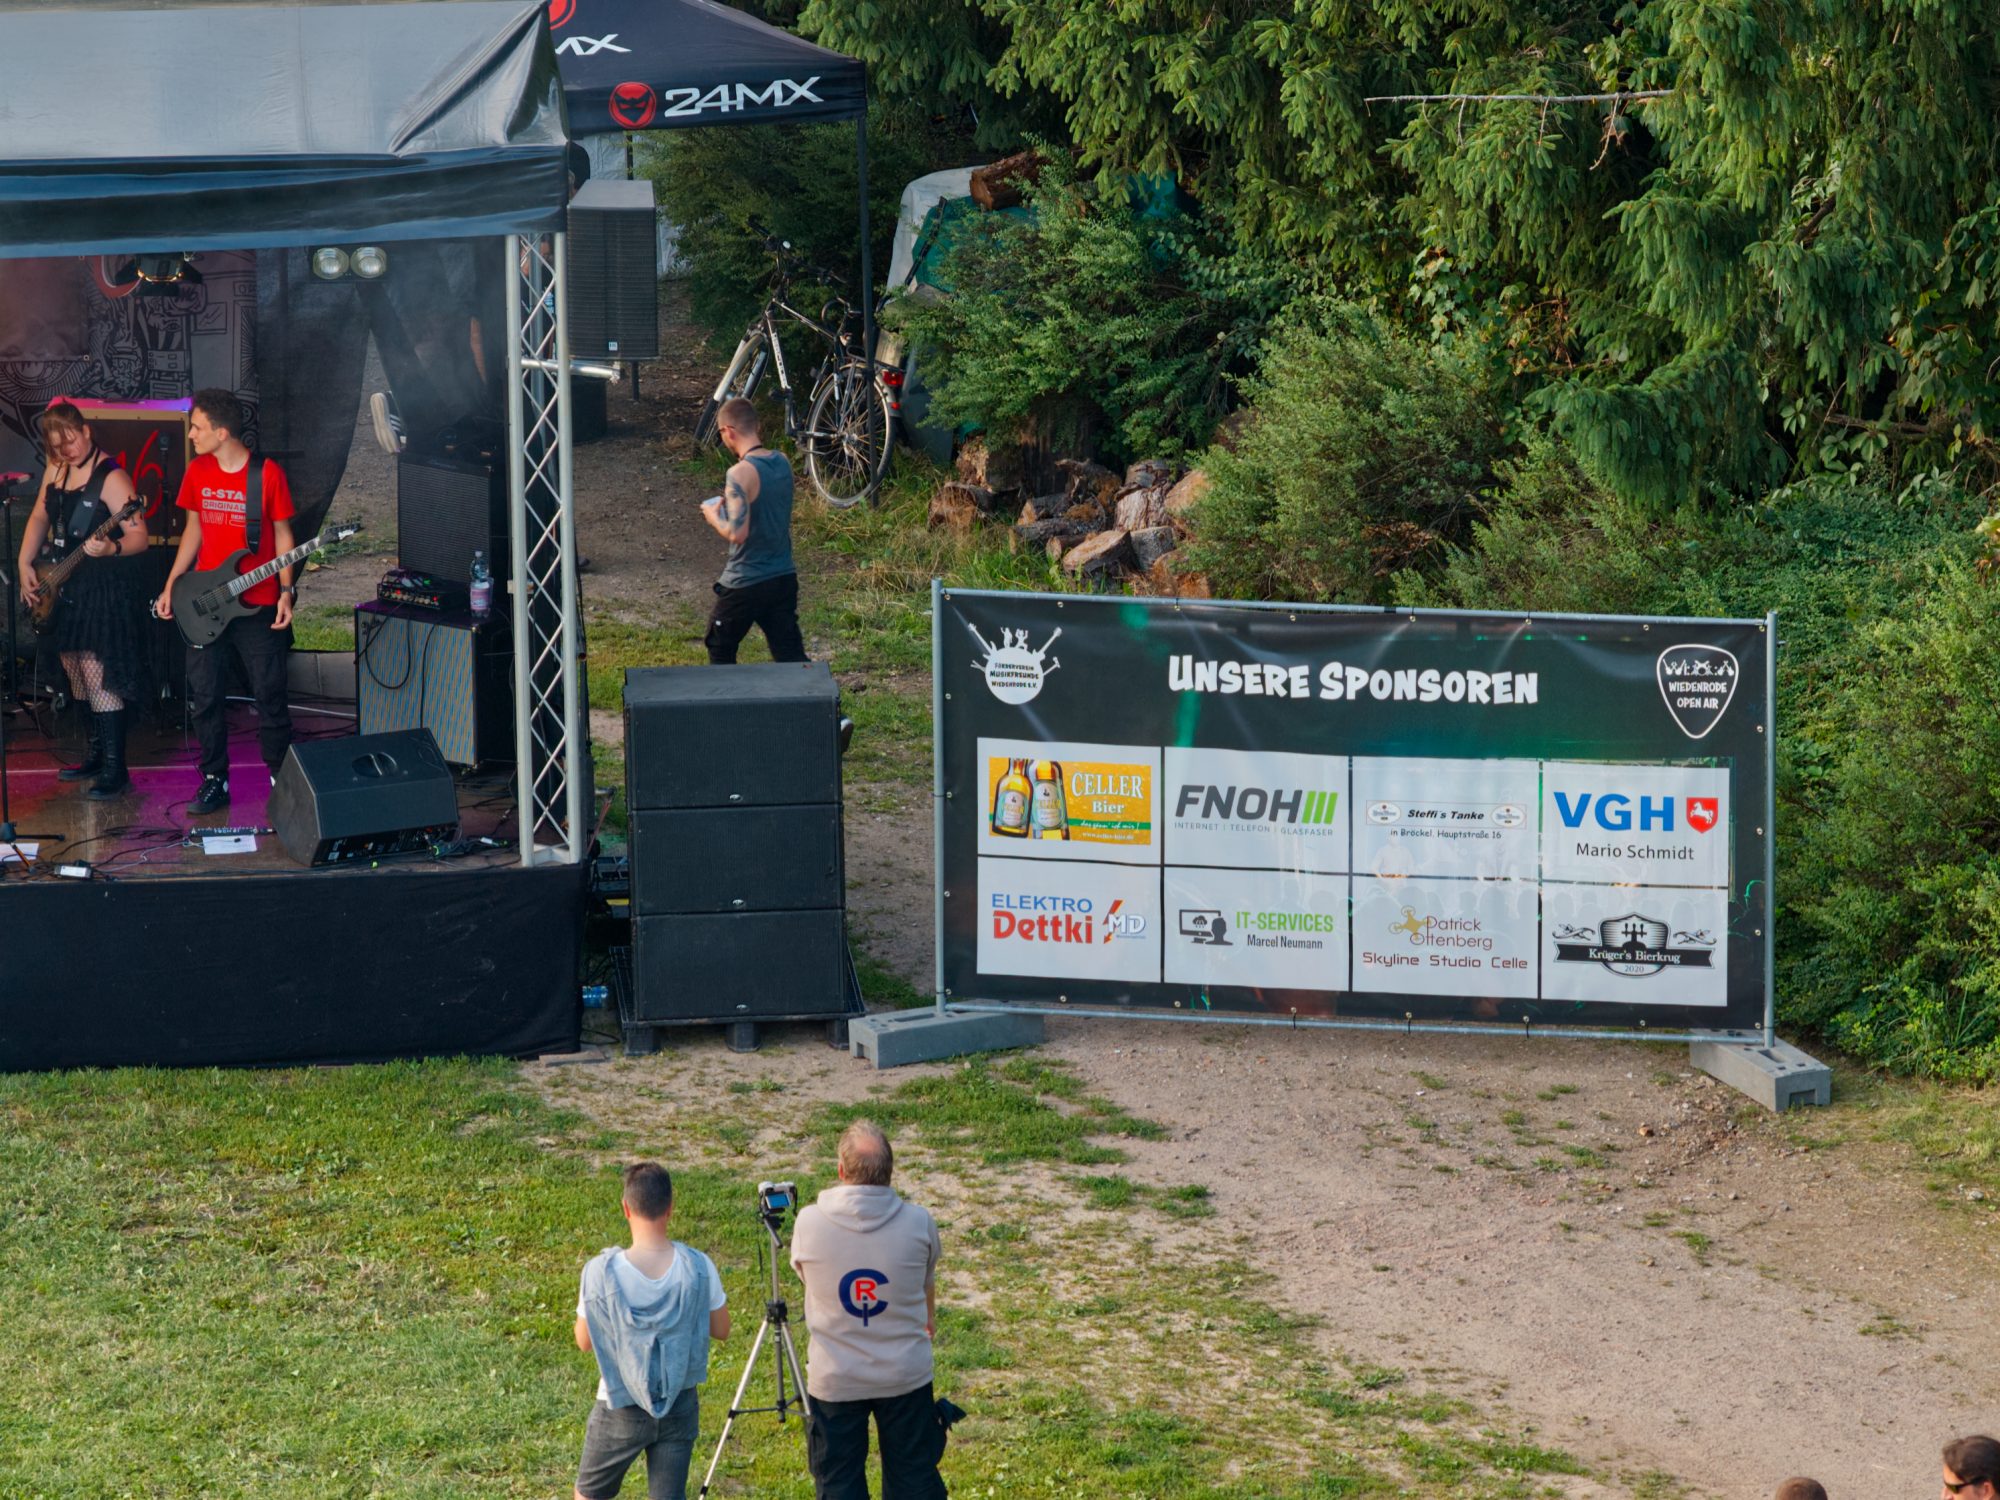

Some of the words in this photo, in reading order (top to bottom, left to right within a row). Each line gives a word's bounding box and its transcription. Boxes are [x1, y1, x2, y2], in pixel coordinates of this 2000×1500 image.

[664, 76, 824, 117] 24MX
[1668, 681, 1728, 694] WIEDENRODE
[1676, 697, 1702, 709] OPEN
[1703, 698, 1719, 710] AIR
[1071, 772, 1144, 799] CELLER
[1092, 800, 1125, 815] Bier
[1450, 811, 1485, 821] Tanke
[1553, 791, 1675, 831] VGH
[1174, 822, 1219, 832] INTERNET
[1230, 823, 1271, 833] TELEFON
[1280, 826, 1334, 837] GLASFASER
[1390, 828, 1398, 836] in
[1437, 830, 1489, 841] Hauptstraße
[1491, 831, 1502, 839] 16
[1576, 842, 1622, 858] Mario
[1627, 844, 1695, 860] Schmidt
[992, 893, 1093, 913] ELEKTRO
[993, 910, 1093, 944] Dettki
[1107, 913, 1147, 934] MD
[1235, 911, 1334, 933] IT-SERVICES
[1426, 915, 1481, 933] Patrick
[1247, 934, 1279, 948] Marcel
[1280, 935, 1323, 950] Neumann
[1410, 932, 1493, 950] Ottenberg
[1362, 952, 1420, 968] Skyline
[1429, 954, 1481, 968] Studio
[1491, 957, 1528, 969] Celle
[1588, 948, 1632, 962] Krüger's
[1635, 951, 1681, 964] Bierkrug
[1624, 964, 1645, 973] 2020
